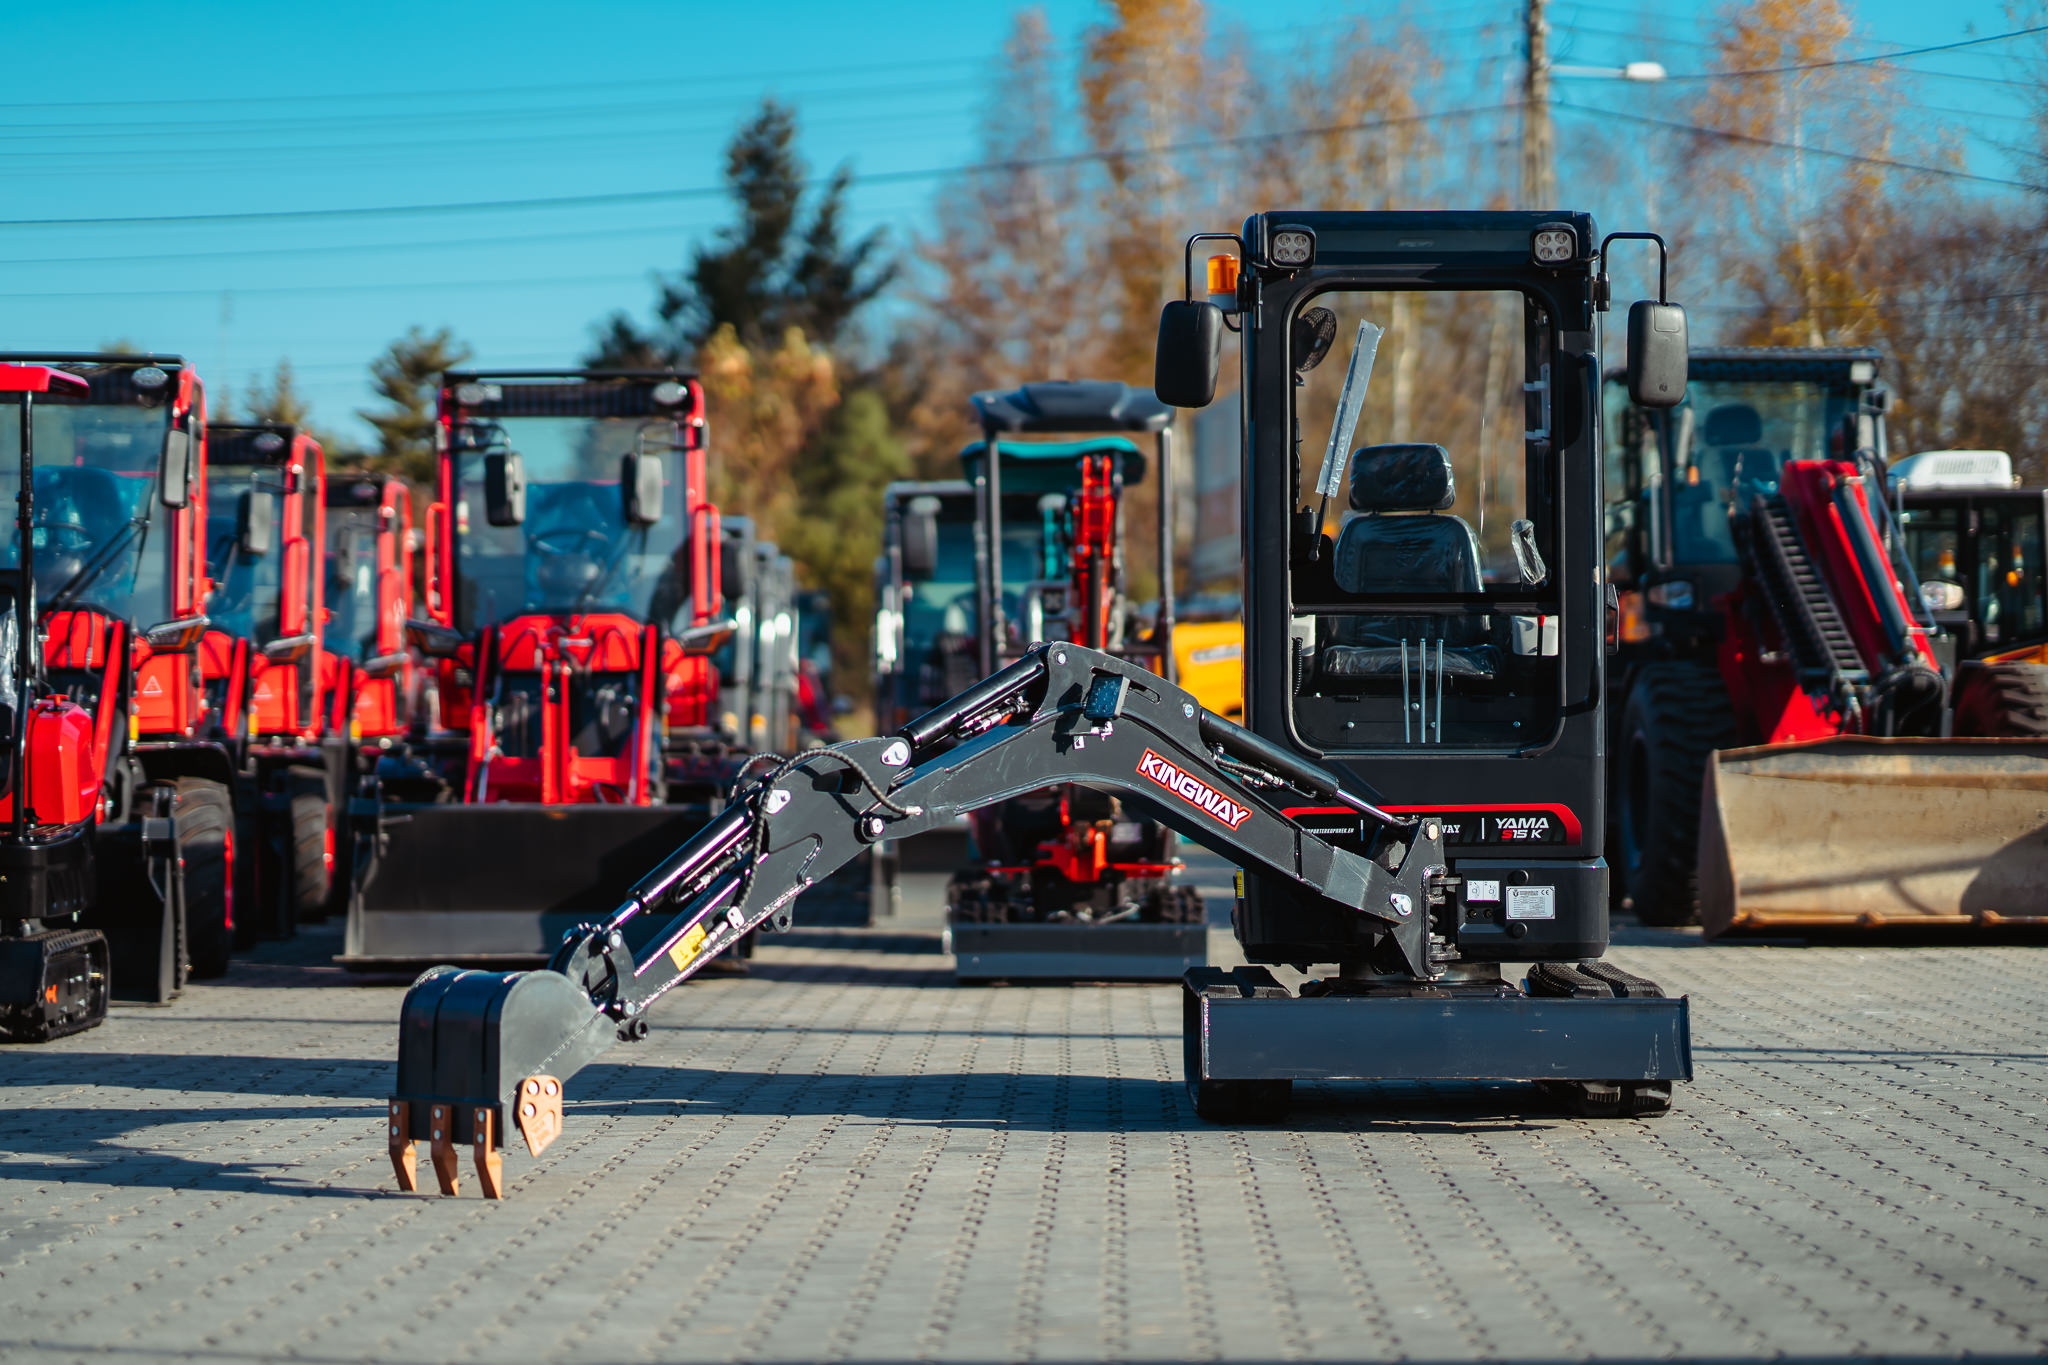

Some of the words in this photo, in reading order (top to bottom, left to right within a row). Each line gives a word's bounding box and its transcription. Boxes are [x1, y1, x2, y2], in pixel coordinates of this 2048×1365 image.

[1139, 751, 1250, 828] KINGWAY
[1495, 817, 1550, 829] YAMA
[1501, 829, 1529, 839] S15
[1531, 829, 1542, 839] K
